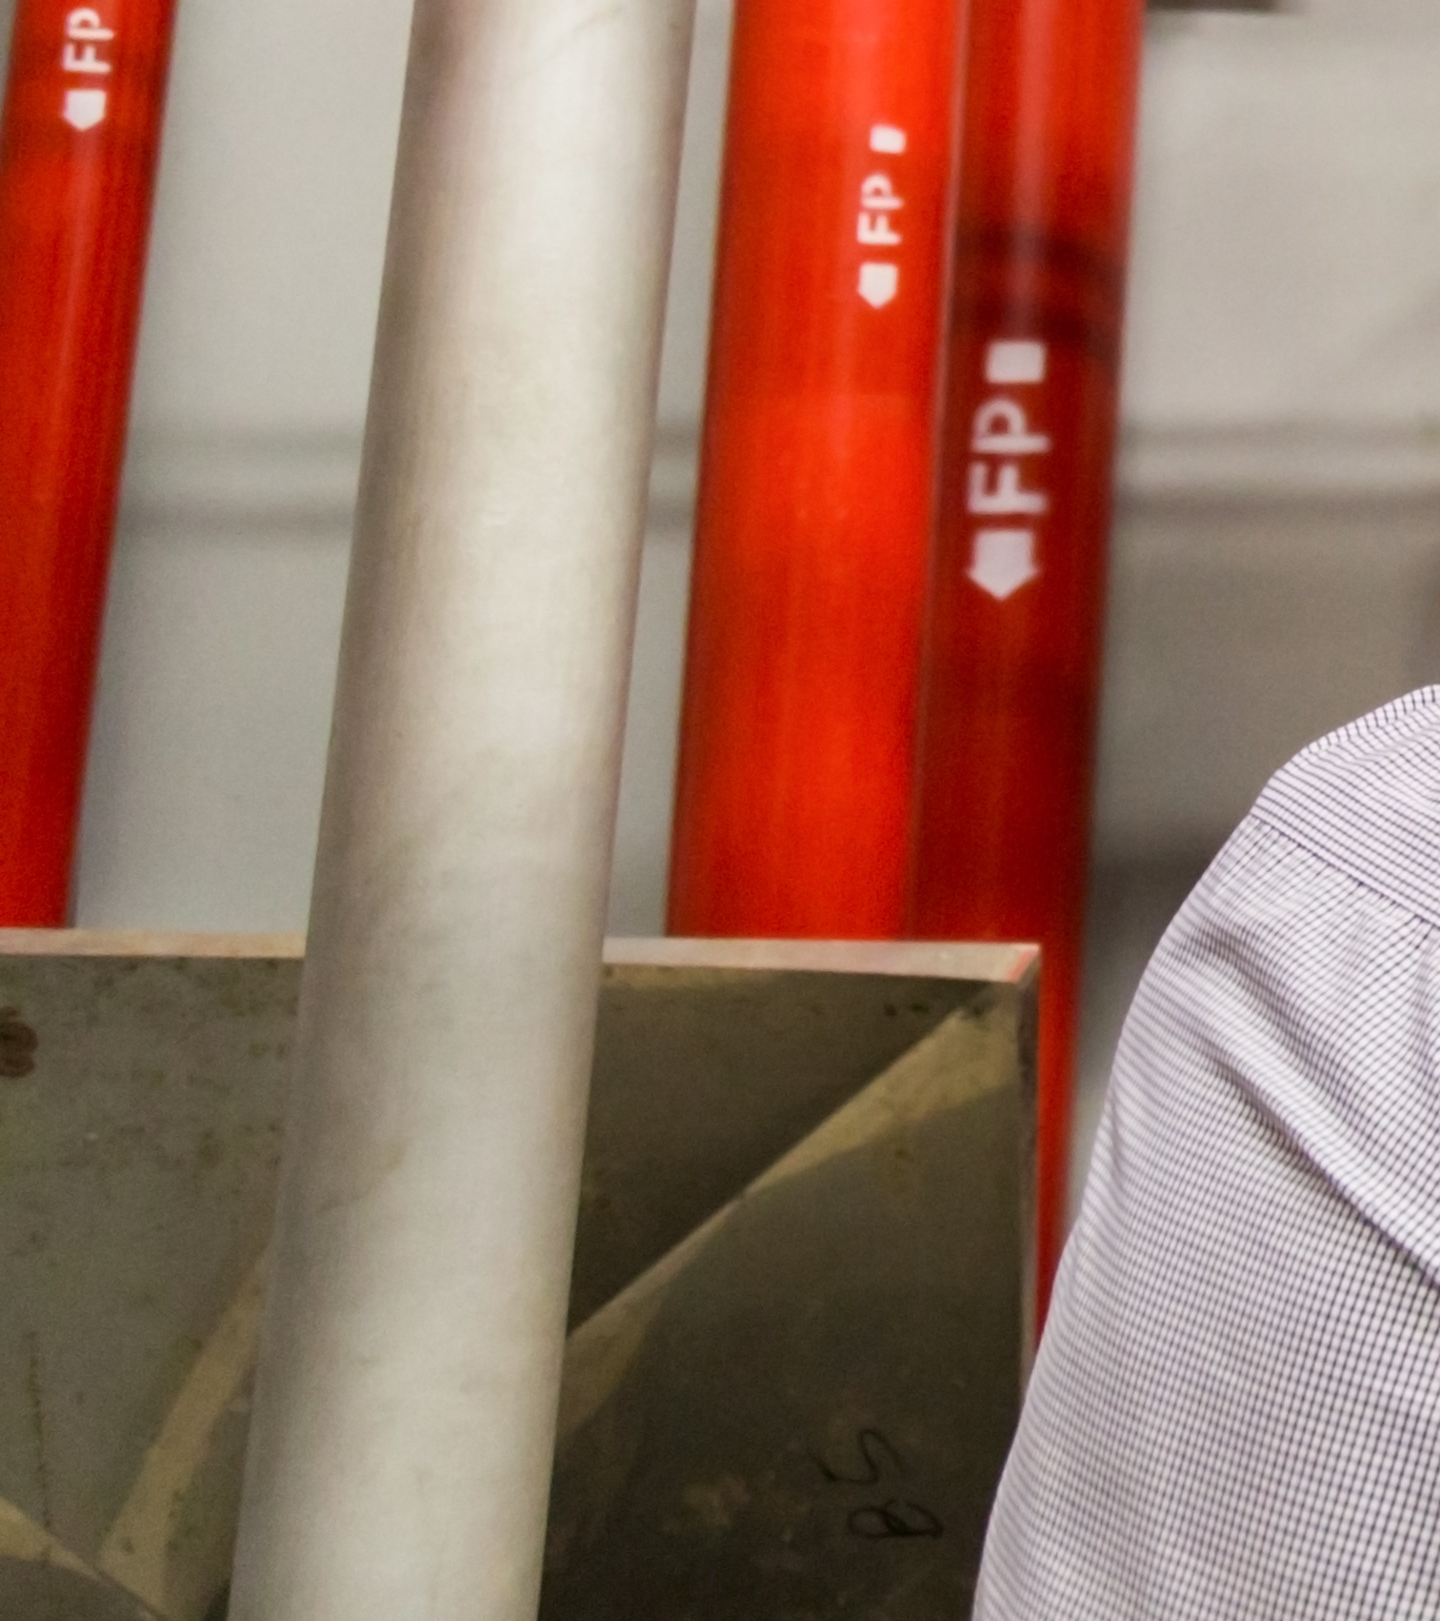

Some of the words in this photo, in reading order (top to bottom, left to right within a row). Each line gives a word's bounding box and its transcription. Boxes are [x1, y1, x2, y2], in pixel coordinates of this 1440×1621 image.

[64, 7, 114, 73] FP
[857, 173, 903, 245] FP
[968, 398, 1049, 515] FP
